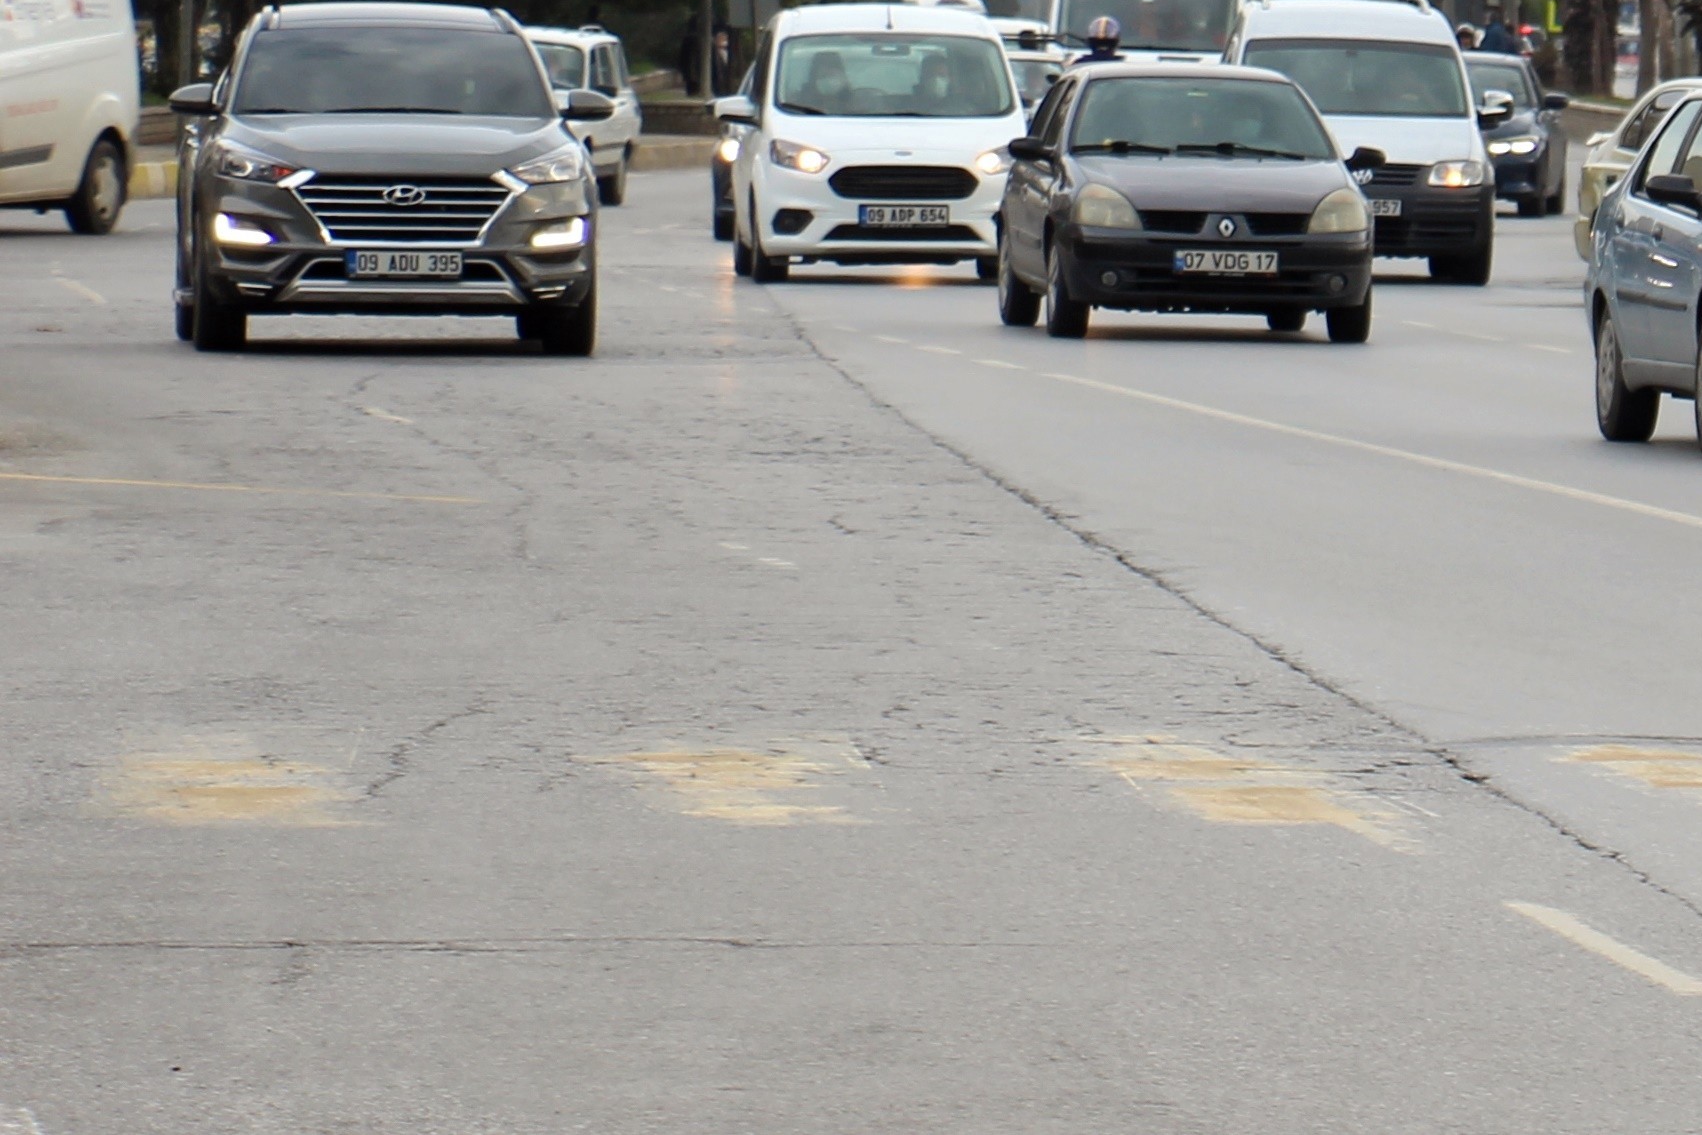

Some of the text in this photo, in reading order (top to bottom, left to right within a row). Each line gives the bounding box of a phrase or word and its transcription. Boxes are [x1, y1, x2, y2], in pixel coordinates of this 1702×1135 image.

[867, 208, 885, 223] 09
[920, 208, 945, 223] 654
[358, 254, 459, 273] 09 ADU 395
[1184, 253, 1275, 270] 07 VDG 17
